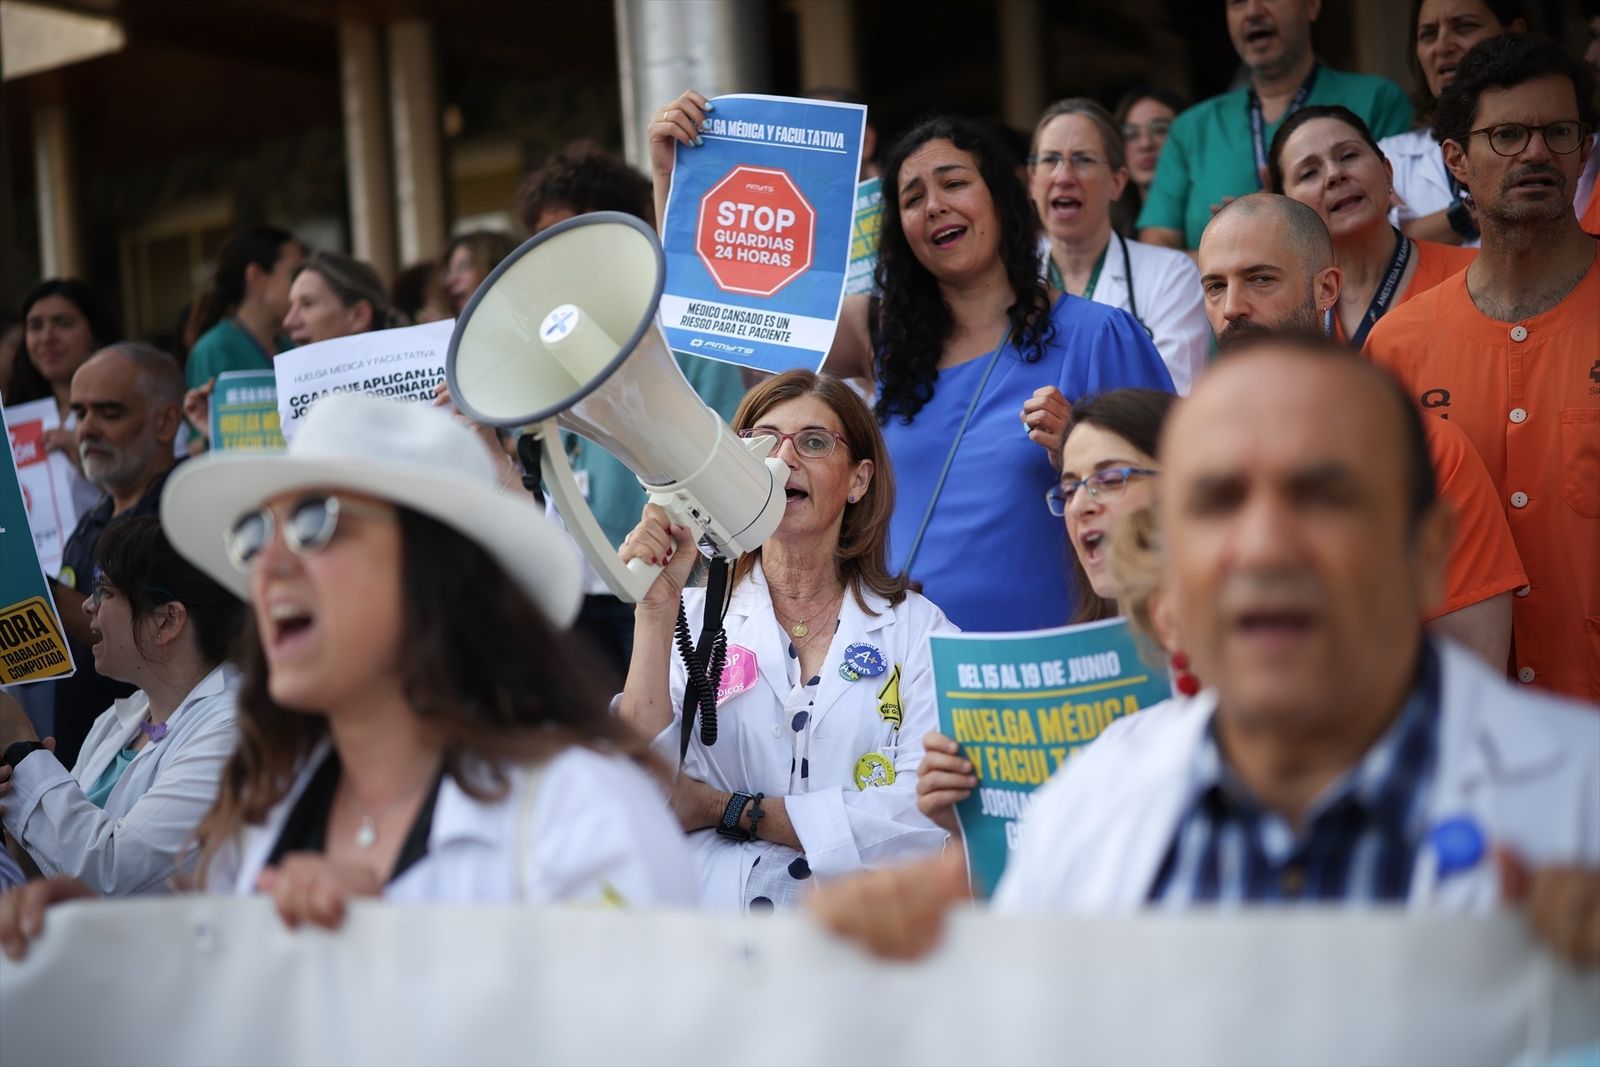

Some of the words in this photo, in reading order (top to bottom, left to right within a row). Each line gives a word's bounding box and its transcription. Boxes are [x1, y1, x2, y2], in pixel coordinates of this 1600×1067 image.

[728, 120, 765, 140] MÉDICA
[767, 125, 776, 141] Y
[775, 126, 844, 149] FACULTATIVA
[717, 200, 796, 233] STOP
[714, 229, 794, 252] GUARDIAS
[715, 245, 734, 260] 24
[737, 248, 792, 268] HORAS
[1377, 268, 1400, 307] ANESTESIA
[680, 315, 712, 330] RIESGO
[712, 320, 735, 335] PARA
[737, 324, 747, 336] EL
[748, 326, 792, 343] PACIENTE
[721, 308, 763, 326] CANSADO
[764, 315, 776, 327] ES
[776, 316, 791, 330] UN
[294, 368, 328, 384] HUELGA
[366, 358, 373, 367] Y
[374, 349, 436, 365] FACULTATIVA
[363, 369, 426, 390] APLICAN
[428, 366, 446, 377] LA
[1, 638, 58, 667] TRABAJADA
[8, 650, 66, 680] COMPUTADA
[957, 663, 982, 689] DEL
[981, 664, 999, 690] 15
[1000, 663, 1022, 689] AL
[1020, 662, 1042, 689] 19
[1041, 659, 1067, 687] DE
[1067, 651, 1121, 684] JUNIO
[951, 708, 1038, 745] HUELGA
[963, 746, 984, 780] Y
